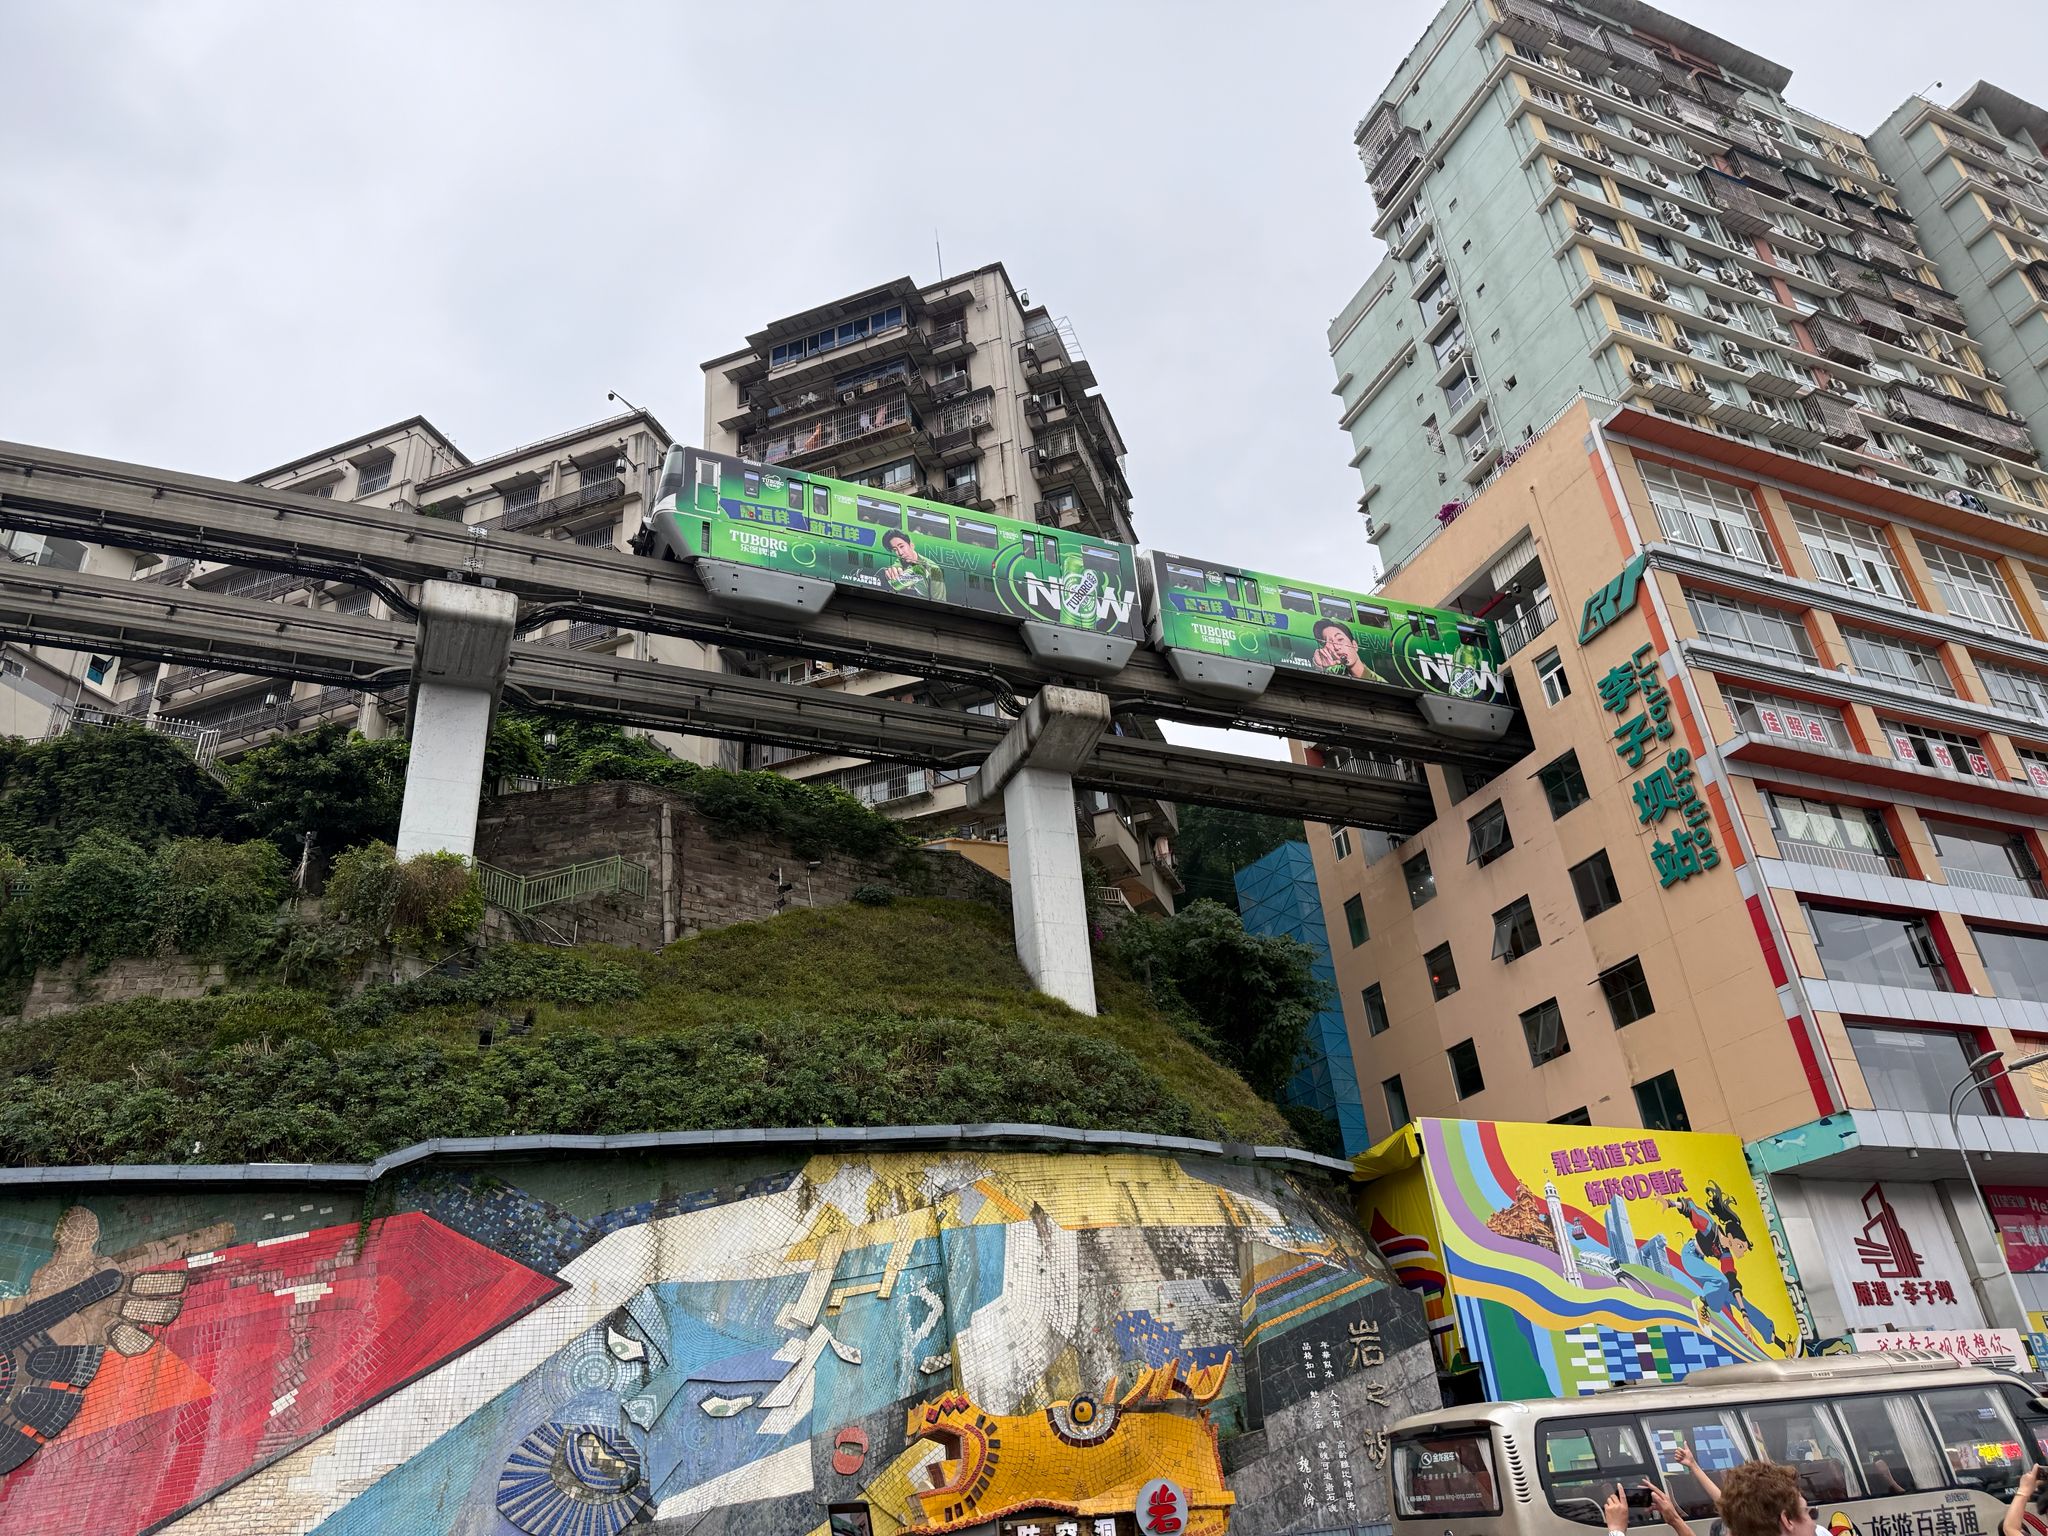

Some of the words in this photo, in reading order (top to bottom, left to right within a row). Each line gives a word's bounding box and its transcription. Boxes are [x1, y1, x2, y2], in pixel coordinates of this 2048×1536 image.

[729, 529, 787, 552] TUBORG
[924, 543, 980, 570] NEW
[1066, 578, 1095, 611] TUBORG
[1191, 623, 1236, 640] TUBORG
[1597, 660, 1702, 890] 李子坝站
[1631, 642, 1675, 743] Liziba
[1666, 747, 1721, 872] Station
[1551, 1138, 1662, 1176] 乘坐轨道交通
[1584, 1168, 1689, 1207] 畅游8D重庆
[1302, 1342, 1316, 1379] 品格如山
[1329, 1389, 1344, 1429] 人生有限
